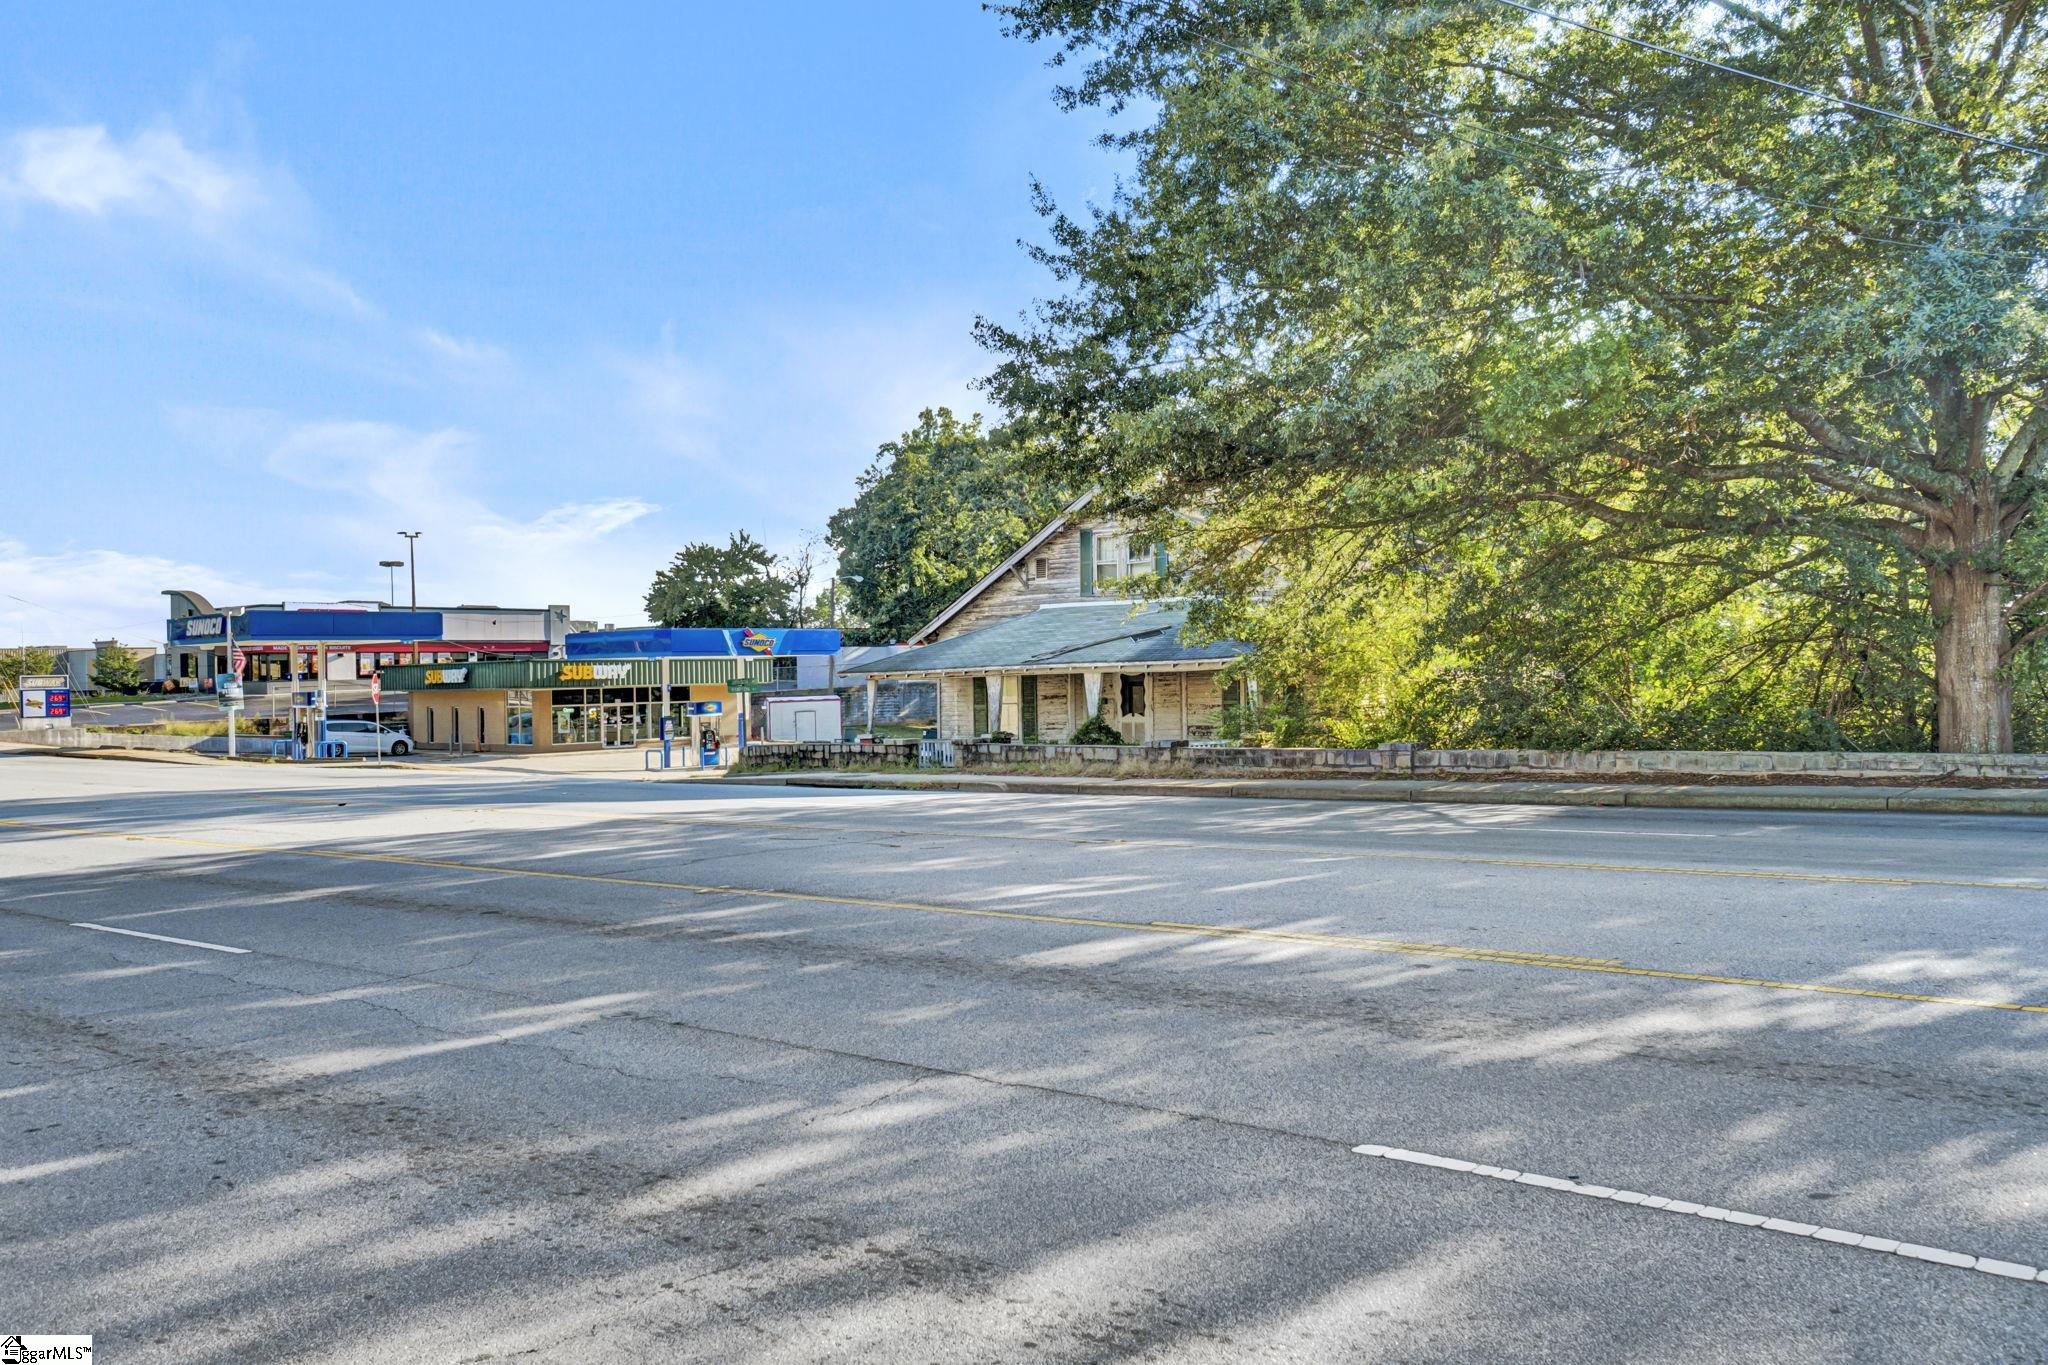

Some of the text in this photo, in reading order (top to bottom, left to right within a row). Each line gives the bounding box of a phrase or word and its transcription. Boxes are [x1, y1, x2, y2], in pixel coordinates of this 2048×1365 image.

[186, 617, 223, 636] SUNOCO
[743, 638, 776, 647] SUNOCO
[425, 667, 468, 685] SUBWAY
[559, 663, 633, 681] SUBWAY
[24, 677, 65, 688] SUBWAY
